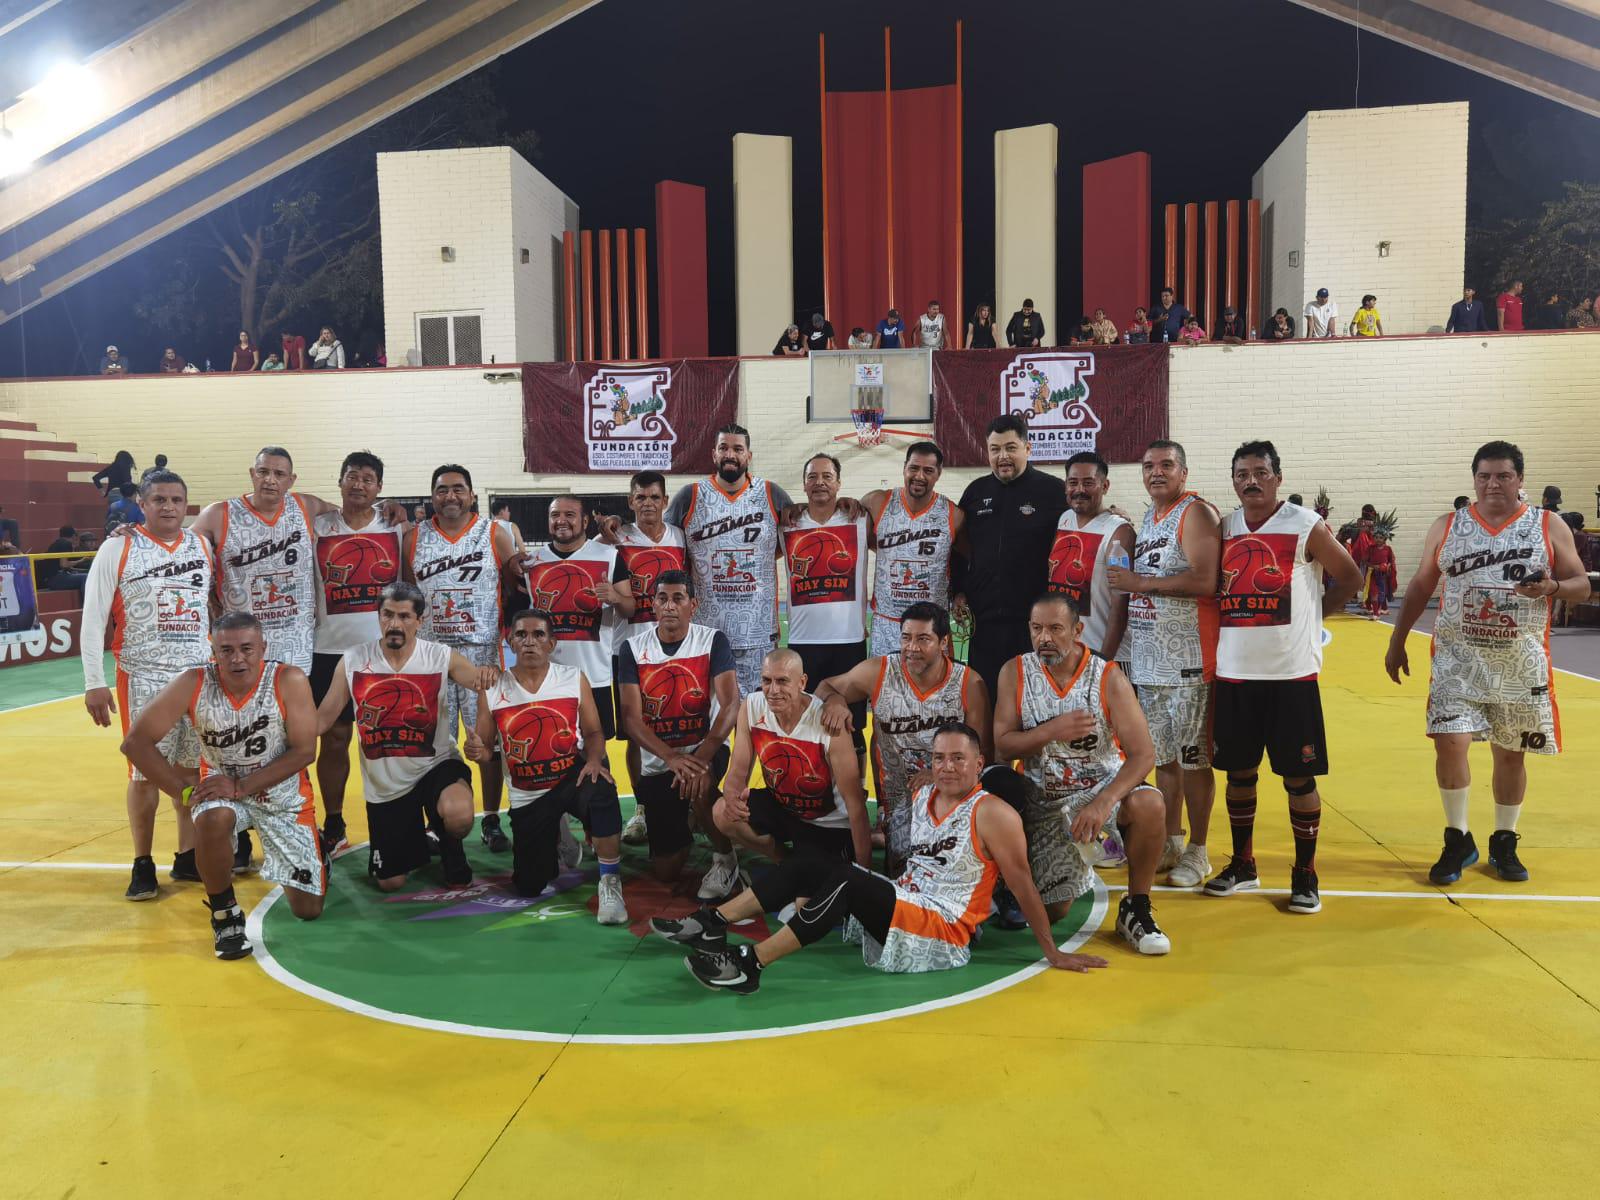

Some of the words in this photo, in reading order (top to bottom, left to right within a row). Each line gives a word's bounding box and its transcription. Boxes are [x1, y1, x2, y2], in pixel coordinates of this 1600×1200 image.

[1028, 430, 1092, 441] NDACIÓN
[592, 441, 669, 451] FUNDACIÓN
[691, 512, 764, 542] LLAMAS
[744, 528, 761, 543] 17
[878, 529, 942, 549] LLAMAS
[918, 541, 937, 556] 15
[285, 548, 298, 566] 8
[1446, 548, 1533, 578] LLAMAS
[457, 566, 482, 582] 77
[1503, 564, 1526, 581] 10
[191, 573, 203, 588] 2
[824, 577, 849, 589] SIN
[1247, 597, 1279, 609] SIN
[569, 614, 593, 626] SIN
[1461, 625, 1518, 639] FUNDACIÓN
[399, 729, 425, 743] SIN
[1521, 731, 1547, 750] 10
[245, 735, 266, 757] 13
[1181, 745, 1199, 764] 12
